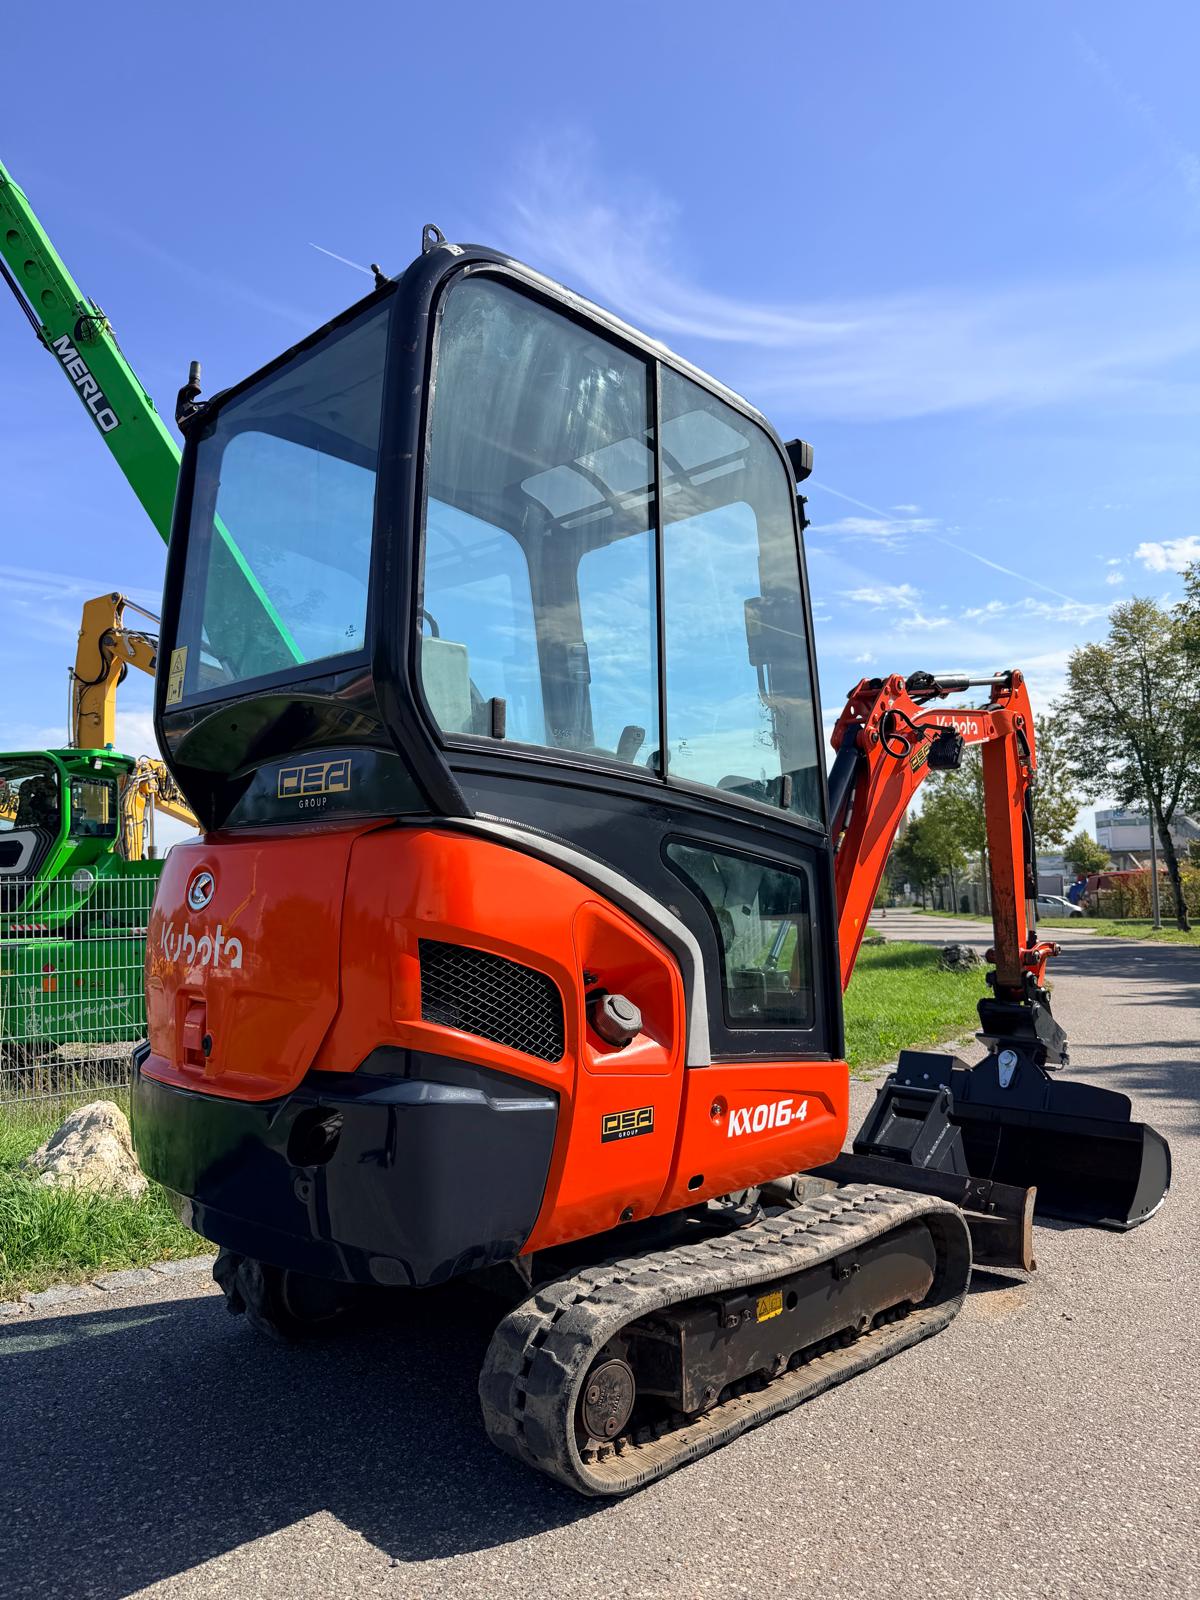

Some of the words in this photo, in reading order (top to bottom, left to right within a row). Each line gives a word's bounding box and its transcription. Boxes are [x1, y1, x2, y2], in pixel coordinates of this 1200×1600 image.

[52, 334, 119, 432] MERLO
[299, 797, 327, 808] GROUP
[160, 921, 243, 969] Kubota
[618, 1129, 638, 1138] GROUP
[727, 1099, 808, 1138] KX016-4
